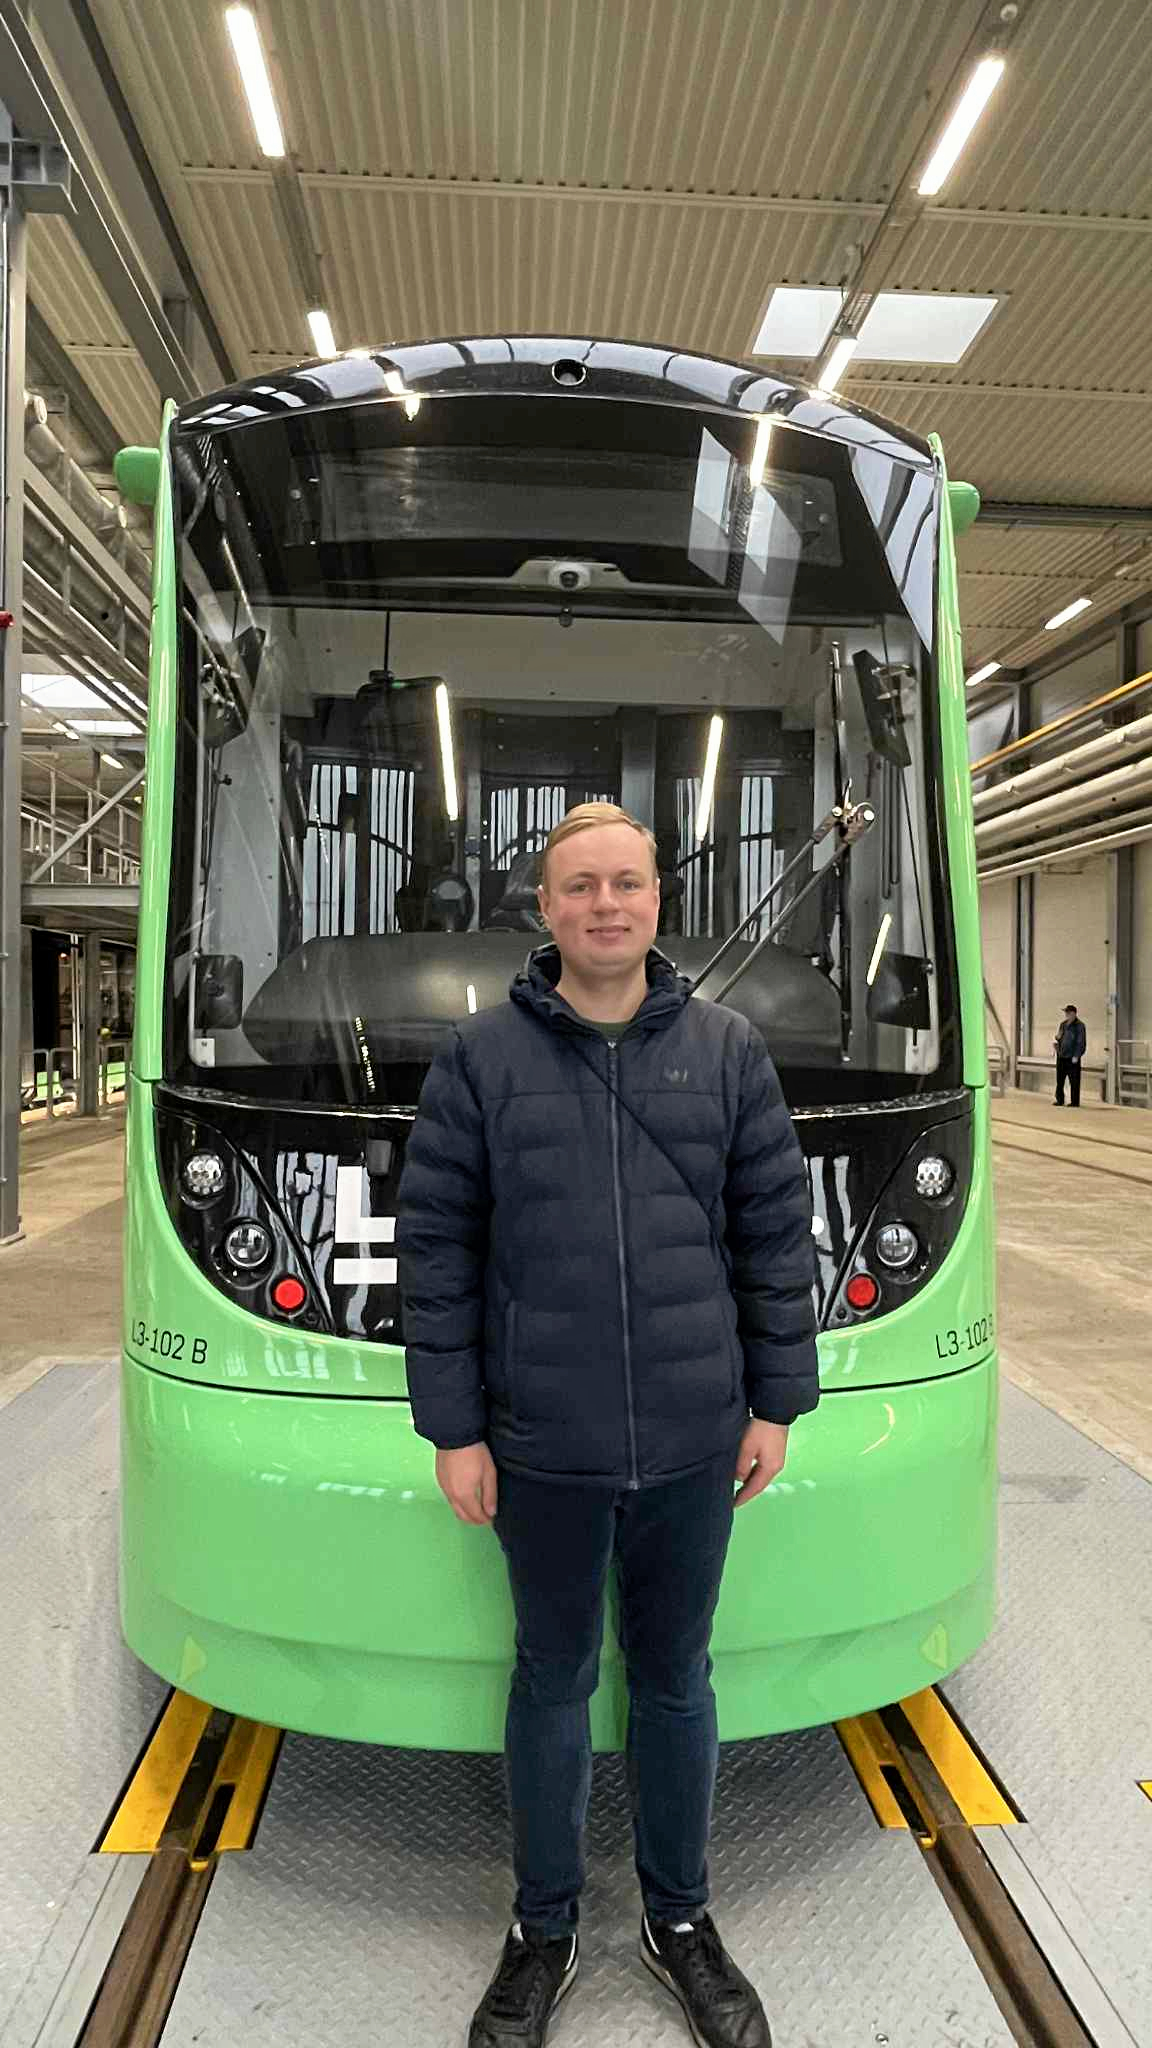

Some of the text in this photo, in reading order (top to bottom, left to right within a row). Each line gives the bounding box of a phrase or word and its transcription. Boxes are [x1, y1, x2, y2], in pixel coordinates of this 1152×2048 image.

[131, 1317, 208, 1364] L3-102 B
[935, 1317, 988, 1358] L3-102
